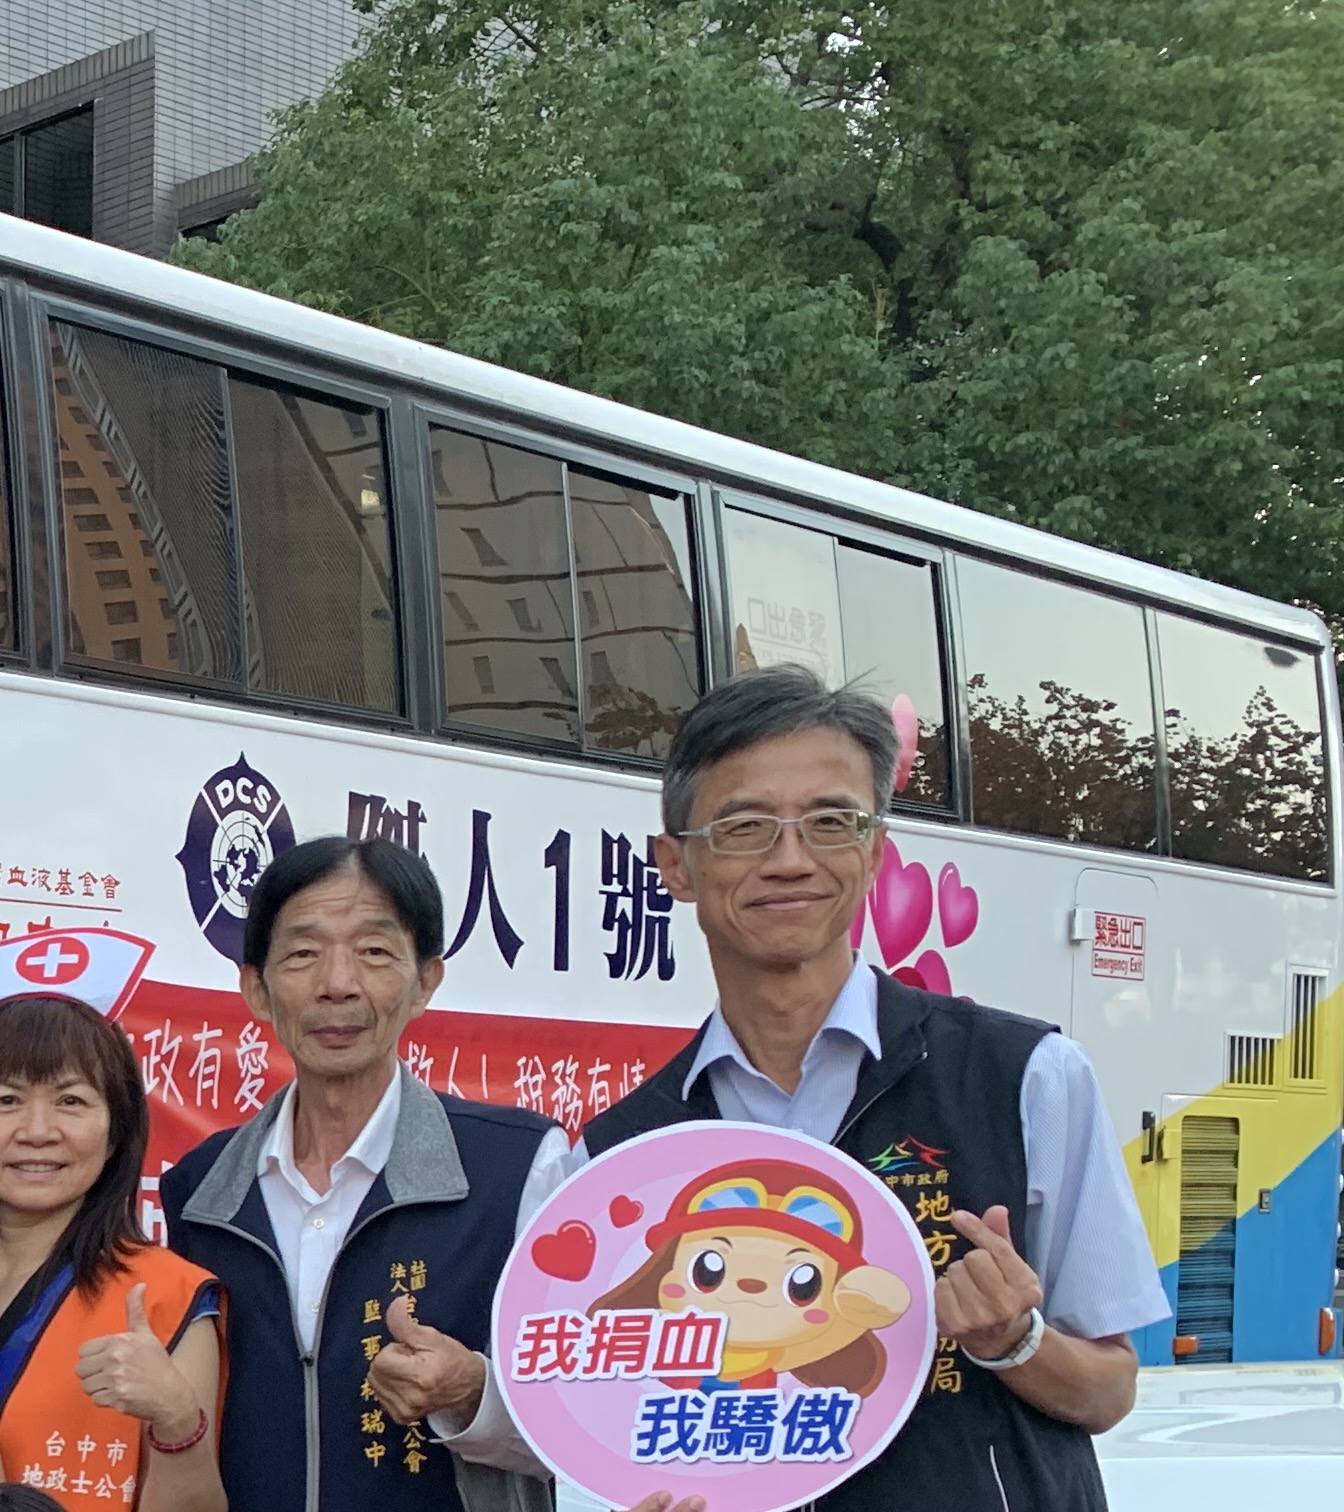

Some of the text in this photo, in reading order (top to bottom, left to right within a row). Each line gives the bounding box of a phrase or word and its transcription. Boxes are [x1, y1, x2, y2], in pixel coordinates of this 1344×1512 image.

[214, 777, 272, 813] DCS
[348, 791, 676, 981] 人1號
[1095, 915, 1143, 950] 緊急出口
[122, 1019, 269, 1113] 政有愛
[879, 1168, 949, 1188] 中市政府
[916, 1190, 963, 1394] 地方局
[516, 1313, 724, 1380] 我捐血
[45, 1430, 128, 1467] 台中市
[637, 1394, 857, 1459] 我驕傲
[21, 1463, 137, 1503] 地政士公會
